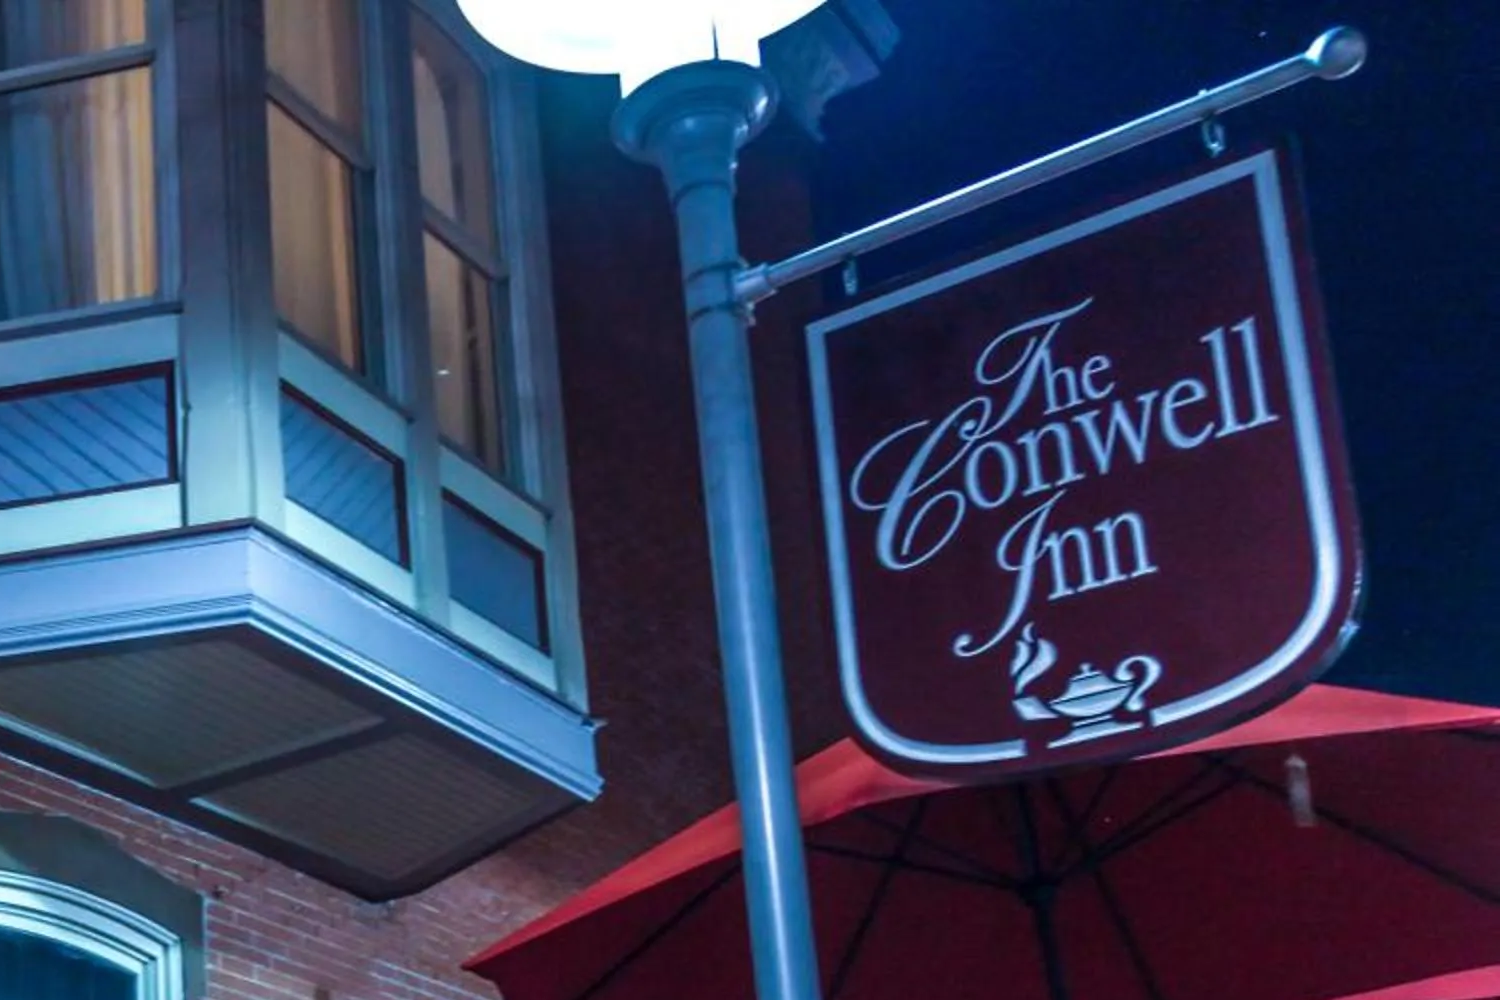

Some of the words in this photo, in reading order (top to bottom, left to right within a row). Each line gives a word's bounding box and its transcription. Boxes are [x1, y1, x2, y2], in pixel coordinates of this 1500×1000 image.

[850, 317, 1281, 570] Conwell
[958, 297, 1116, 440] The
[952, 489, 1159, 657] Inn
